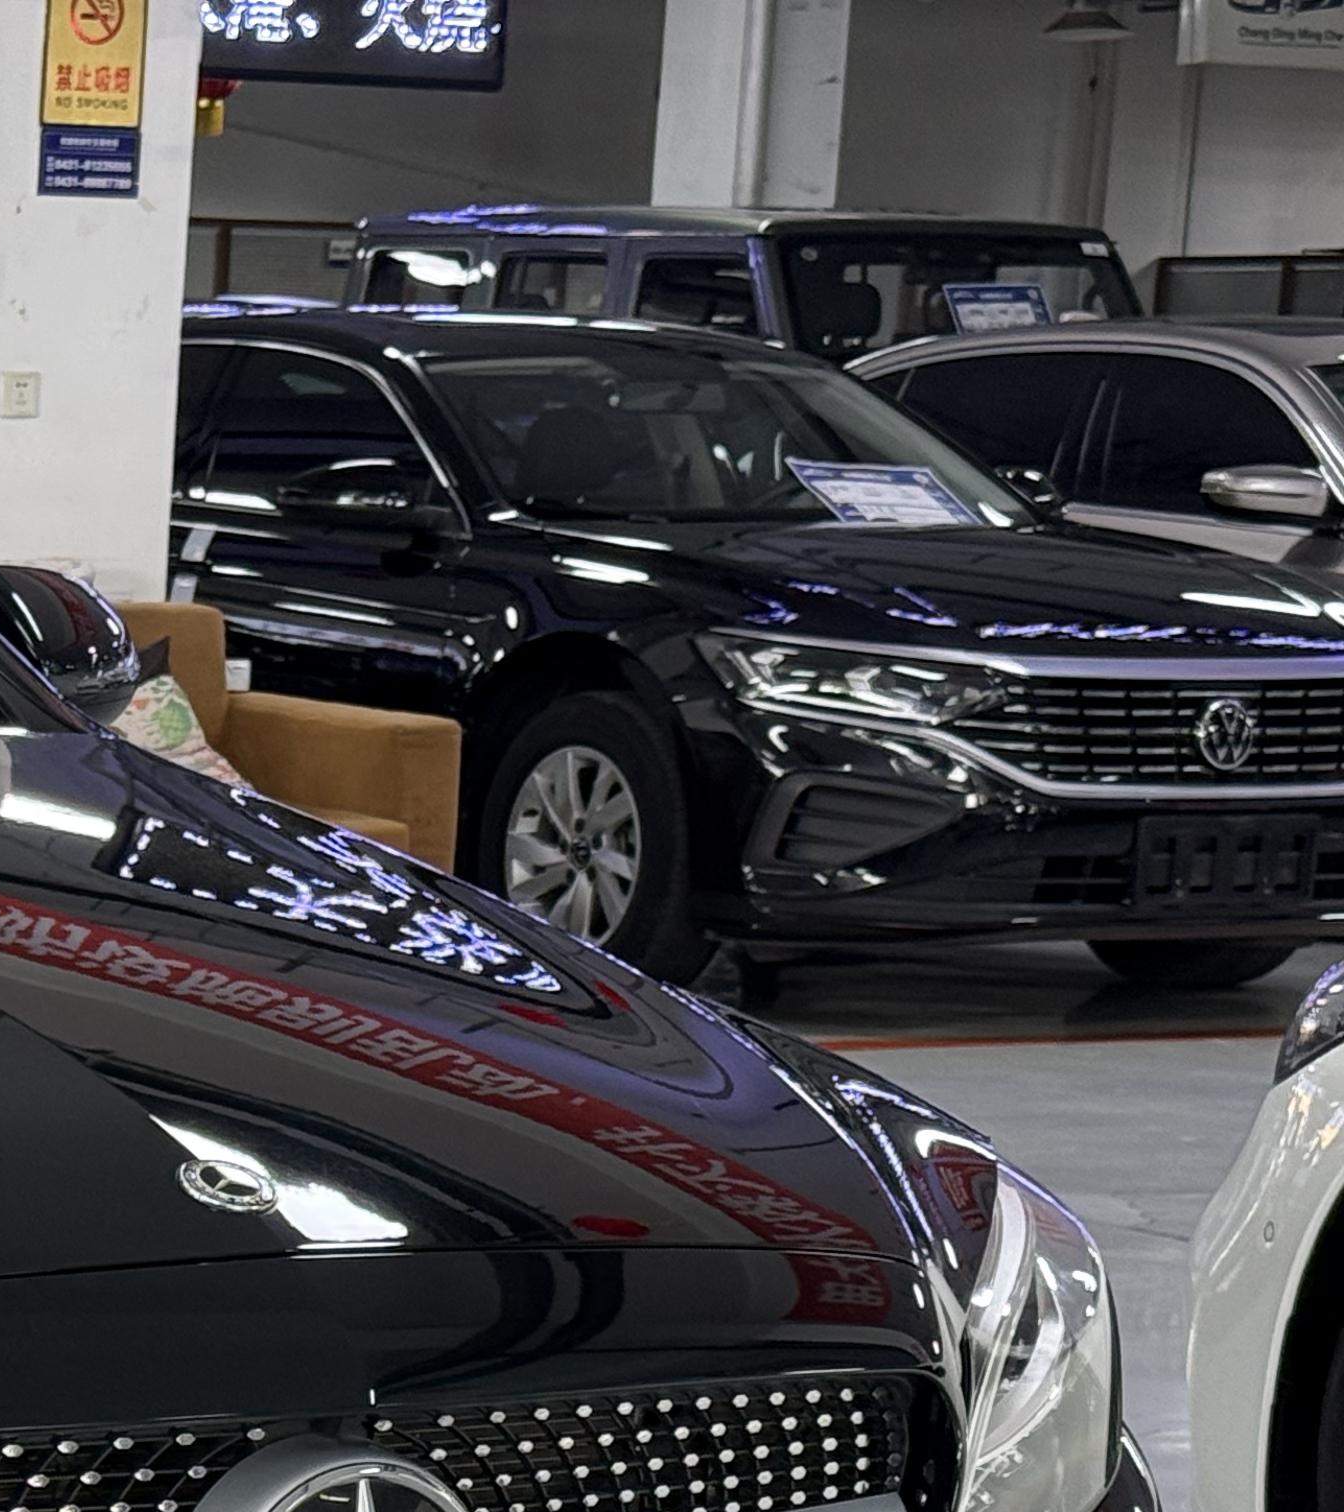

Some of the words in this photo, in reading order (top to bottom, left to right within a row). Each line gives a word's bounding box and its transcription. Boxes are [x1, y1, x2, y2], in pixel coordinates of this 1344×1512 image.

[55, 64, 131, 93] 禁止吸烟
[55, 97, 73, 108] NO
[76, 98, 129, 111] SMOKING
